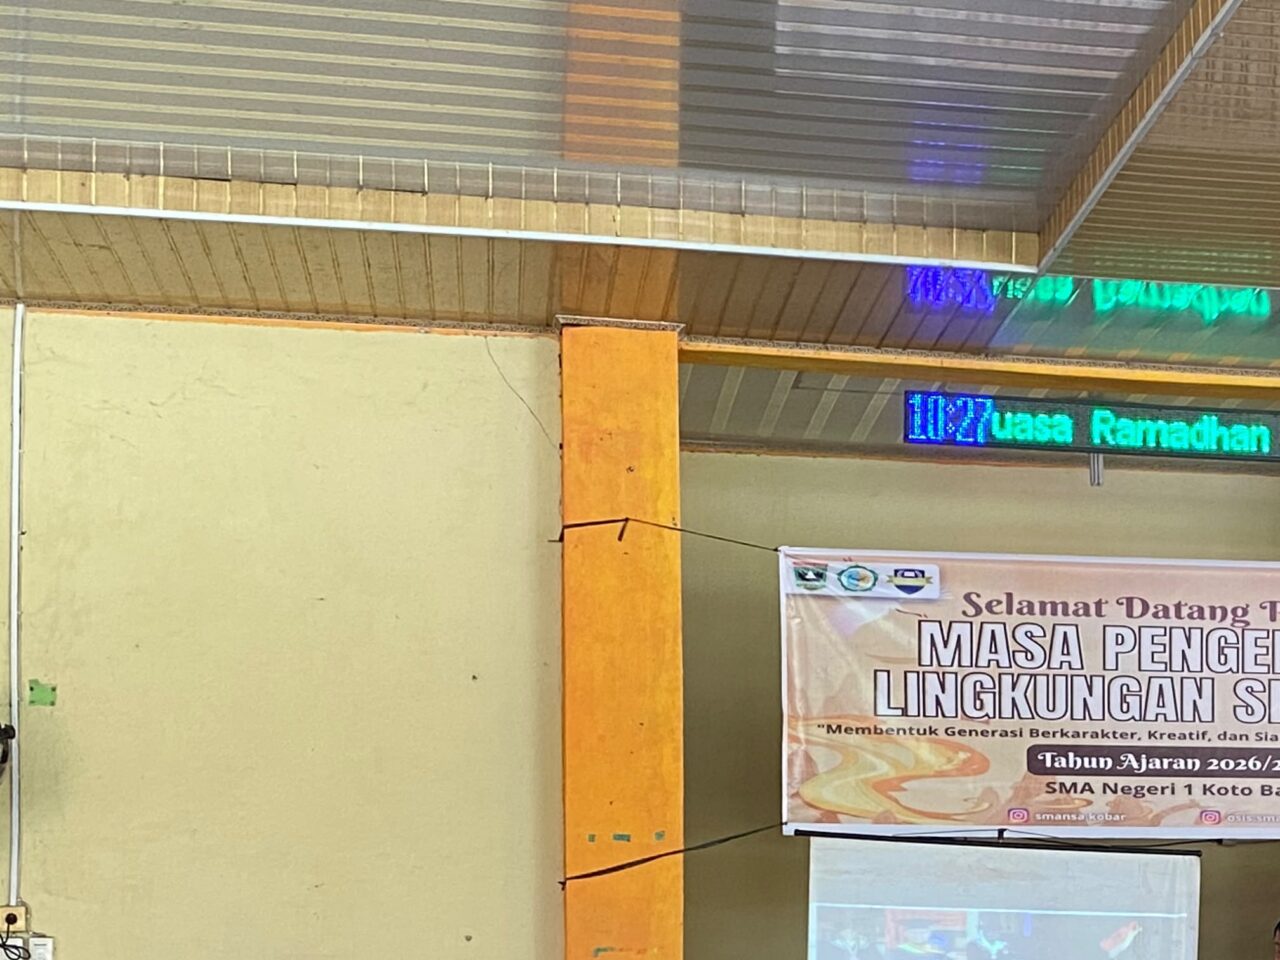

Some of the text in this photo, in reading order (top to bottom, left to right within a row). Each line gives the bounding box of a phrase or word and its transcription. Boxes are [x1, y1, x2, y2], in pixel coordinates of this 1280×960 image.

[1091, 409, 1269, 453] Ramadhan
[961, 591, 1108, 619] Selamat
[1116, 595, 1250, 628] Datang
[917, 619, 1083, 669] MASA
[874, 670, 1215, 723] LINGKUNGAN
[817, 723, 939, 737] "Membentuk
[944, 726, 1024, 738] Generasi
[1029, 728, 1142, 742] Berkarakter,
[1148, 730, 1212, 743] Kreatif,
[1217, 731, 1249, 742] dan
[1037, 752, 1114, 773] Tahun
[1115, 752, 1200, 774] Ajaran
[1044, 781, 1095, 795] SMA
[1102, 782, 1176, 798] Negeri
[1184, 783, 1194, 796] 1
[1202, 783, 1253, 797] Koto
